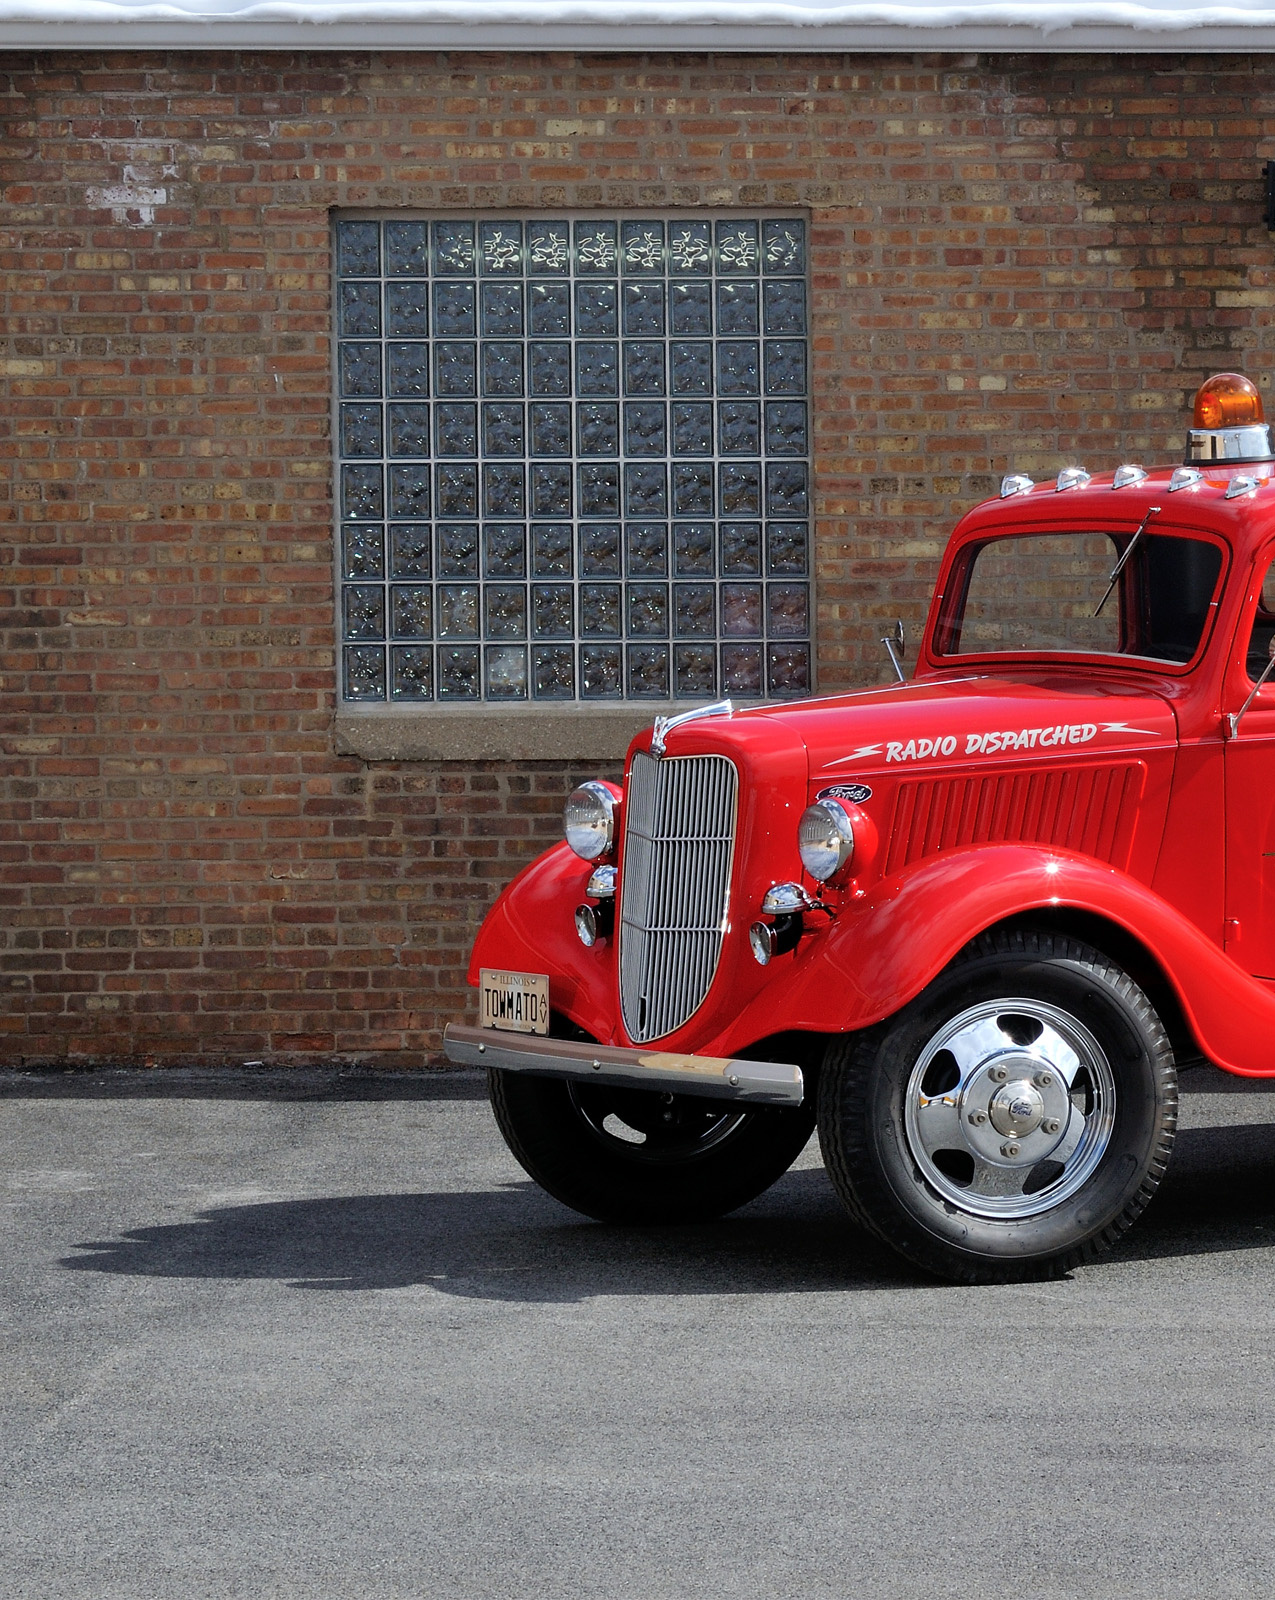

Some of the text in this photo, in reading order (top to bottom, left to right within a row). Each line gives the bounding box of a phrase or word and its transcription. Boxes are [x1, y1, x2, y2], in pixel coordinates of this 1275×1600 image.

[885, 723, 1098, 763] RADIO DISPATCHED
[500, 975, 531, 987] ILLINOIS
[485, 988, 538, 1022] TOWMATO
